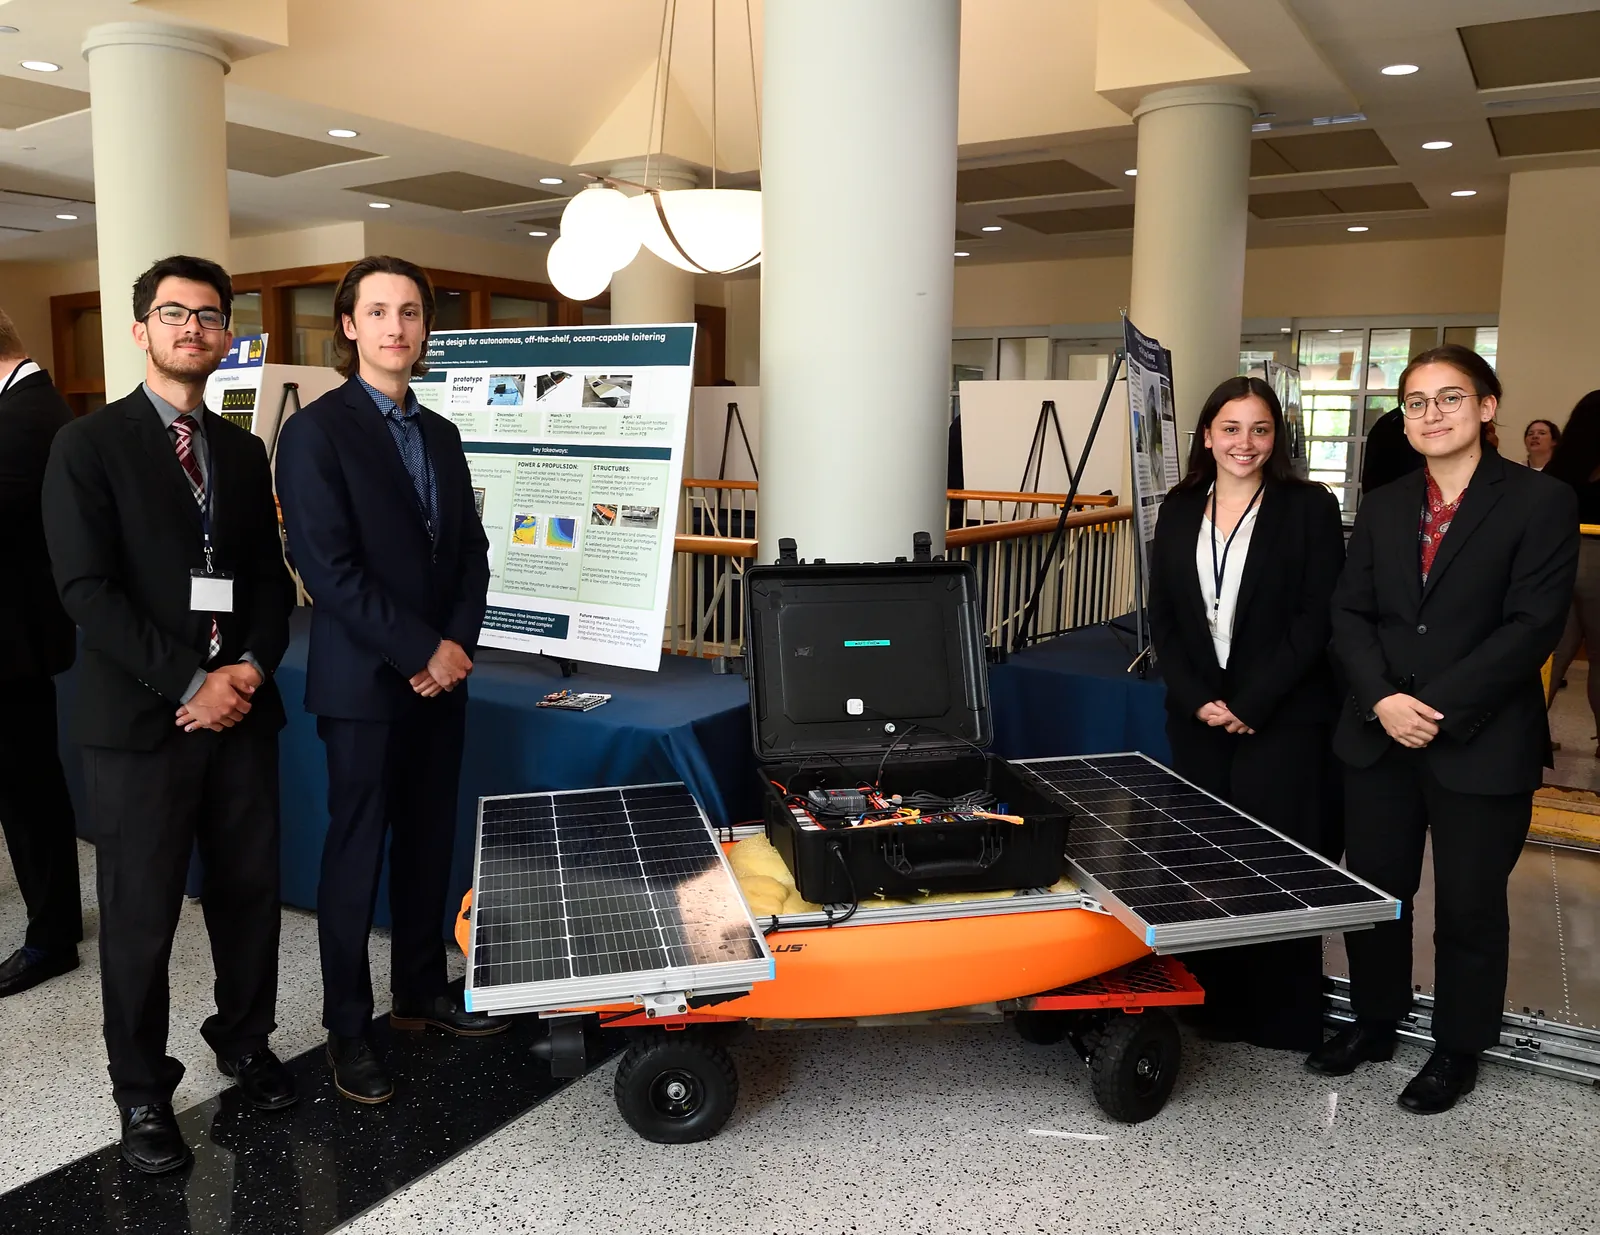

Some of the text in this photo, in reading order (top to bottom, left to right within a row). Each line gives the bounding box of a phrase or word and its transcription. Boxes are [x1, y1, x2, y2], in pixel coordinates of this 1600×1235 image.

[446, 338, 468, 348] design
[468, 336, 478, 345] for
[480, 336, 524, 346] autonomous,
[525, 334, 572, 344] off-the-shelf,
[573, 333, 630, 344] ocean-capable
[632, 332, 666, 342] loitering
[453, 376, 482, 384] prototype
[452, 385, 474, 393] history
[618, 570, 647, 578] time-consuming
[768, 944, 803, 952] LUS
